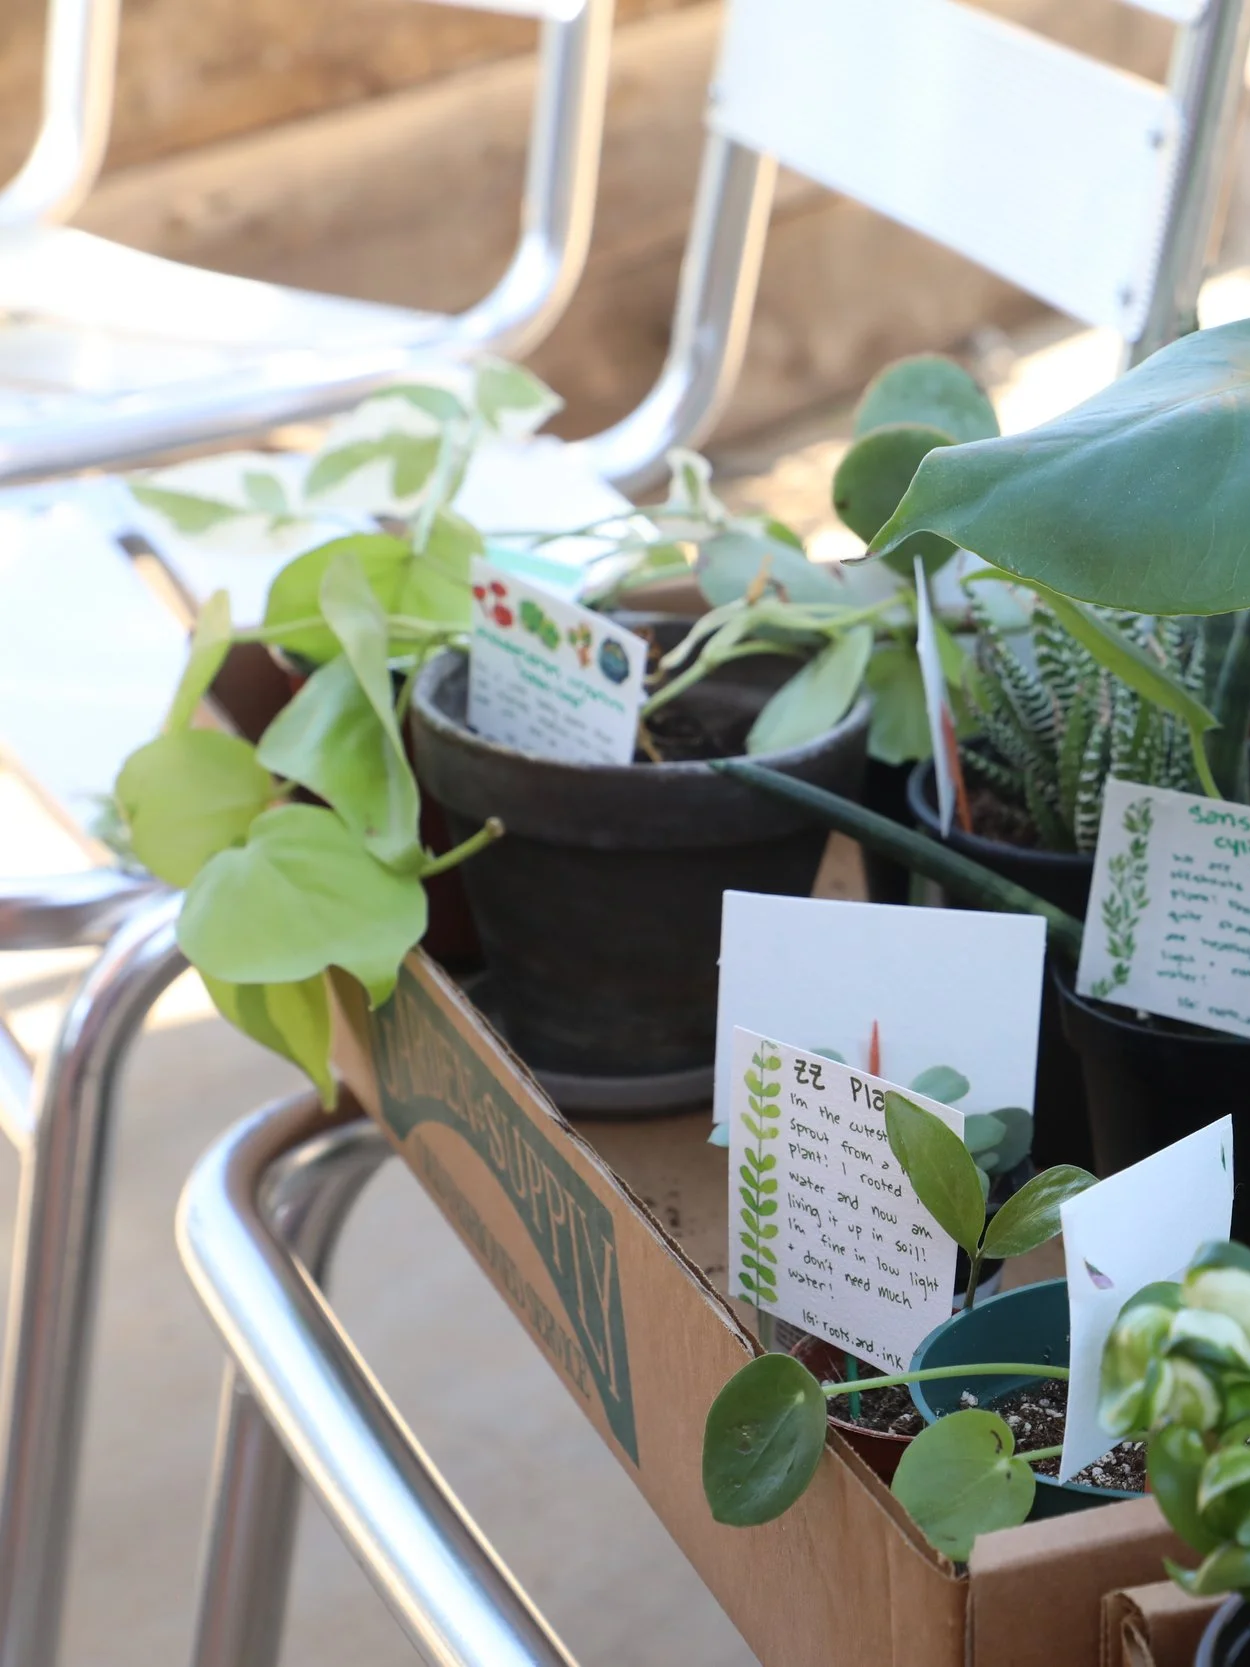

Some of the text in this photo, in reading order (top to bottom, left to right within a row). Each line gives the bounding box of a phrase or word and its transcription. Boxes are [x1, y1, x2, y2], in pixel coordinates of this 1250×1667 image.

[794, 1059, 886, 1111] ZZ Pla
[790, 1092, 888, 1143] I'm the cutest
[841, 1140, 873, 1165] from
[881, 1161, 890, 1170] a
[842, 1161, 847, 1176] I
[860, 1173, 902, 1198] rooted
[788, 1194, 822, 1228] living
[828, 1209, 839, 1227] it
[848, 1223, 862, 1240] up
[872, 1229, 883, 1243] in
[789, 1171, 933, 1240] water and now am
[788, 1217, 939, 1301] I'm fine in low light
[788, 1268, 834, 1300] water!
[803, 1250, 834, 1275] don't
[845, 1272, 871, 1292] need
[878, 1286, 913, 1310] much
[803, 1309, 818, 1326] IG:
